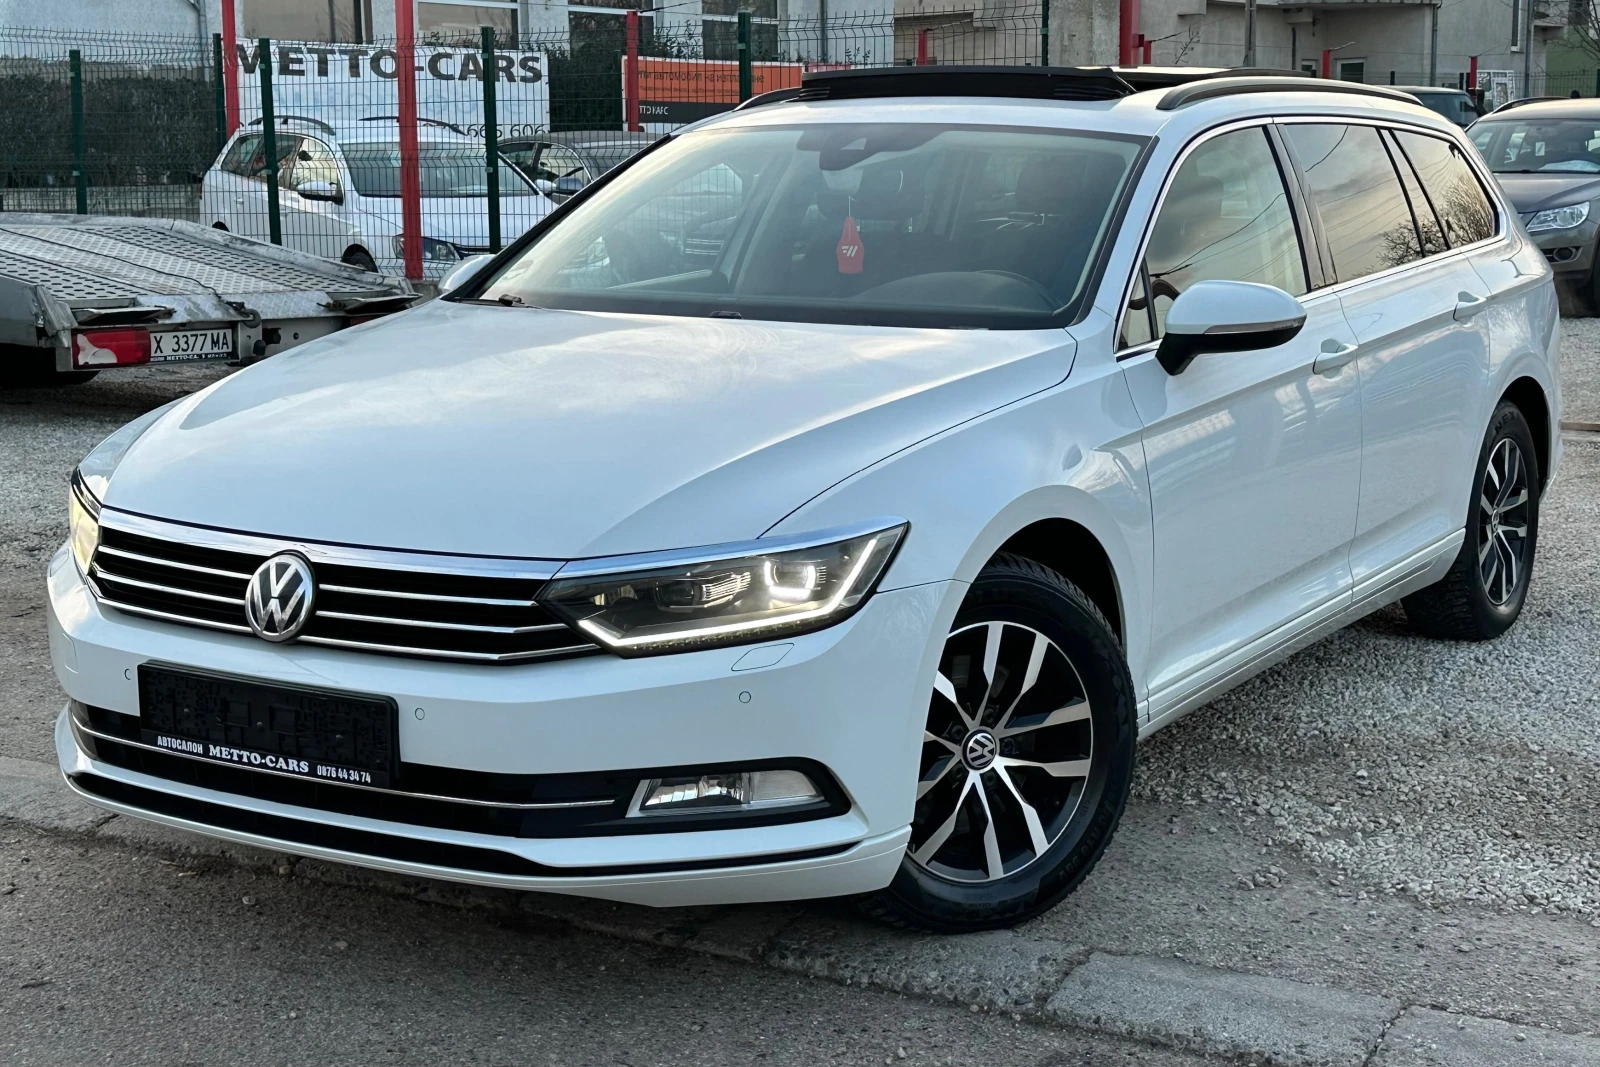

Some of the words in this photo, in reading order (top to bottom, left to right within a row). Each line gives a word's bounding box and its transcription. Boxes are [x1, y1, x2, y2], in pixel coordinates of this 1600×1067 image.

[153, 335, 163, 354] X
[171, 333, 207, 353] 3377
[210, 331, 229, 351] MA
[157, 735, 203, 754] АВТОСАЛОН
[208, 744, 309, 773] METTO-CARS
[317, 765, 337, 778] 0876
[338, 769, 348, 780] 44
[349, 771, 359, 782] 34
[361, 772, 371, 784] 74
